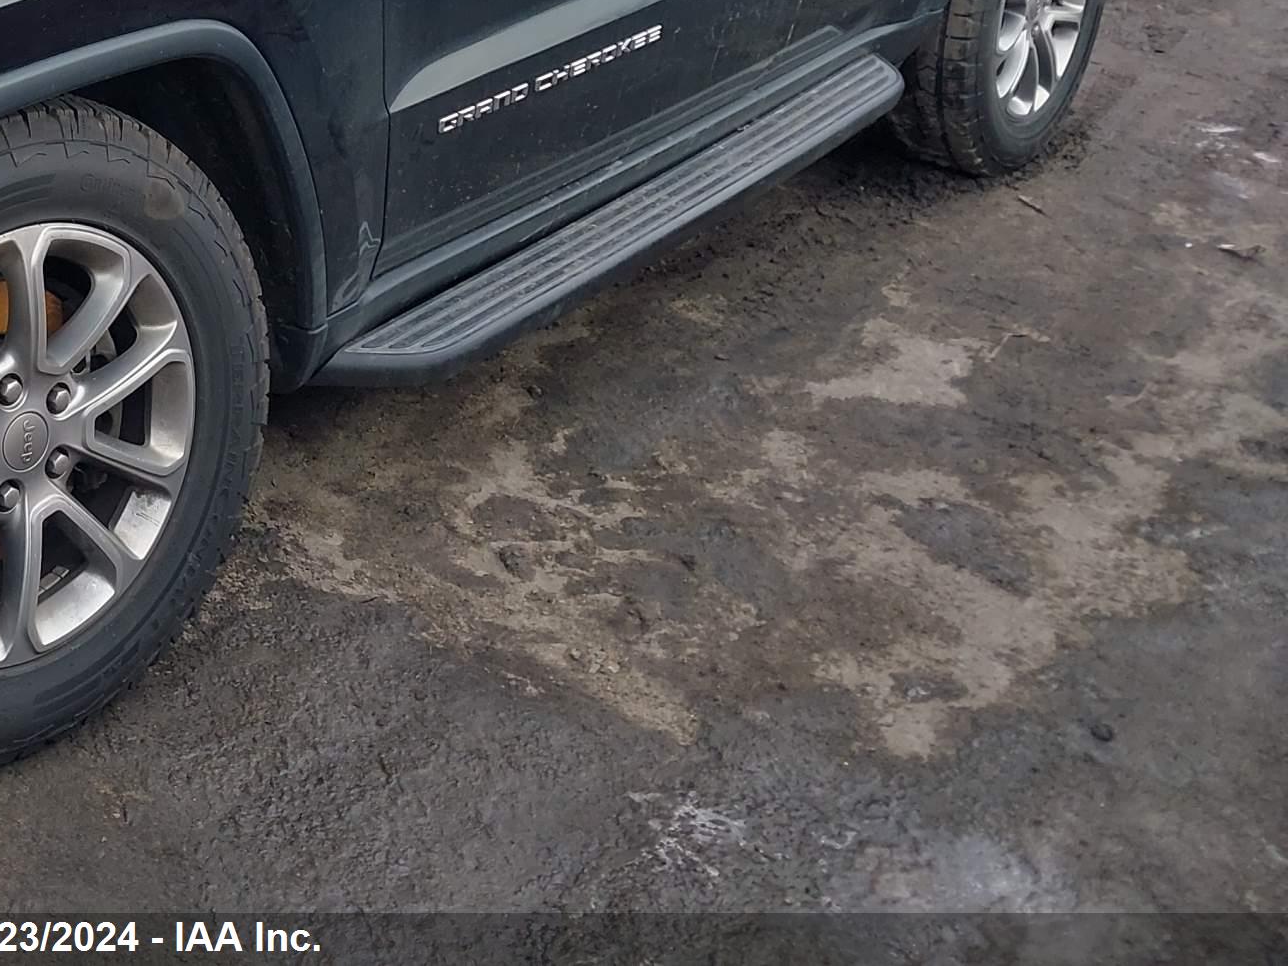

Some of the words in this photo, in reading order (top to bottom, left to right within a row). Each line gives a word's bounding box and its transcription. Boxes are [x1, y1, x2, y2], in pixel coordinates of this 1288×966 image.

[438, 82, 529, 134] GRAND
[534, 24, 664, 94] CHEROKEE
[20, 419, 37, 464] Jeep
